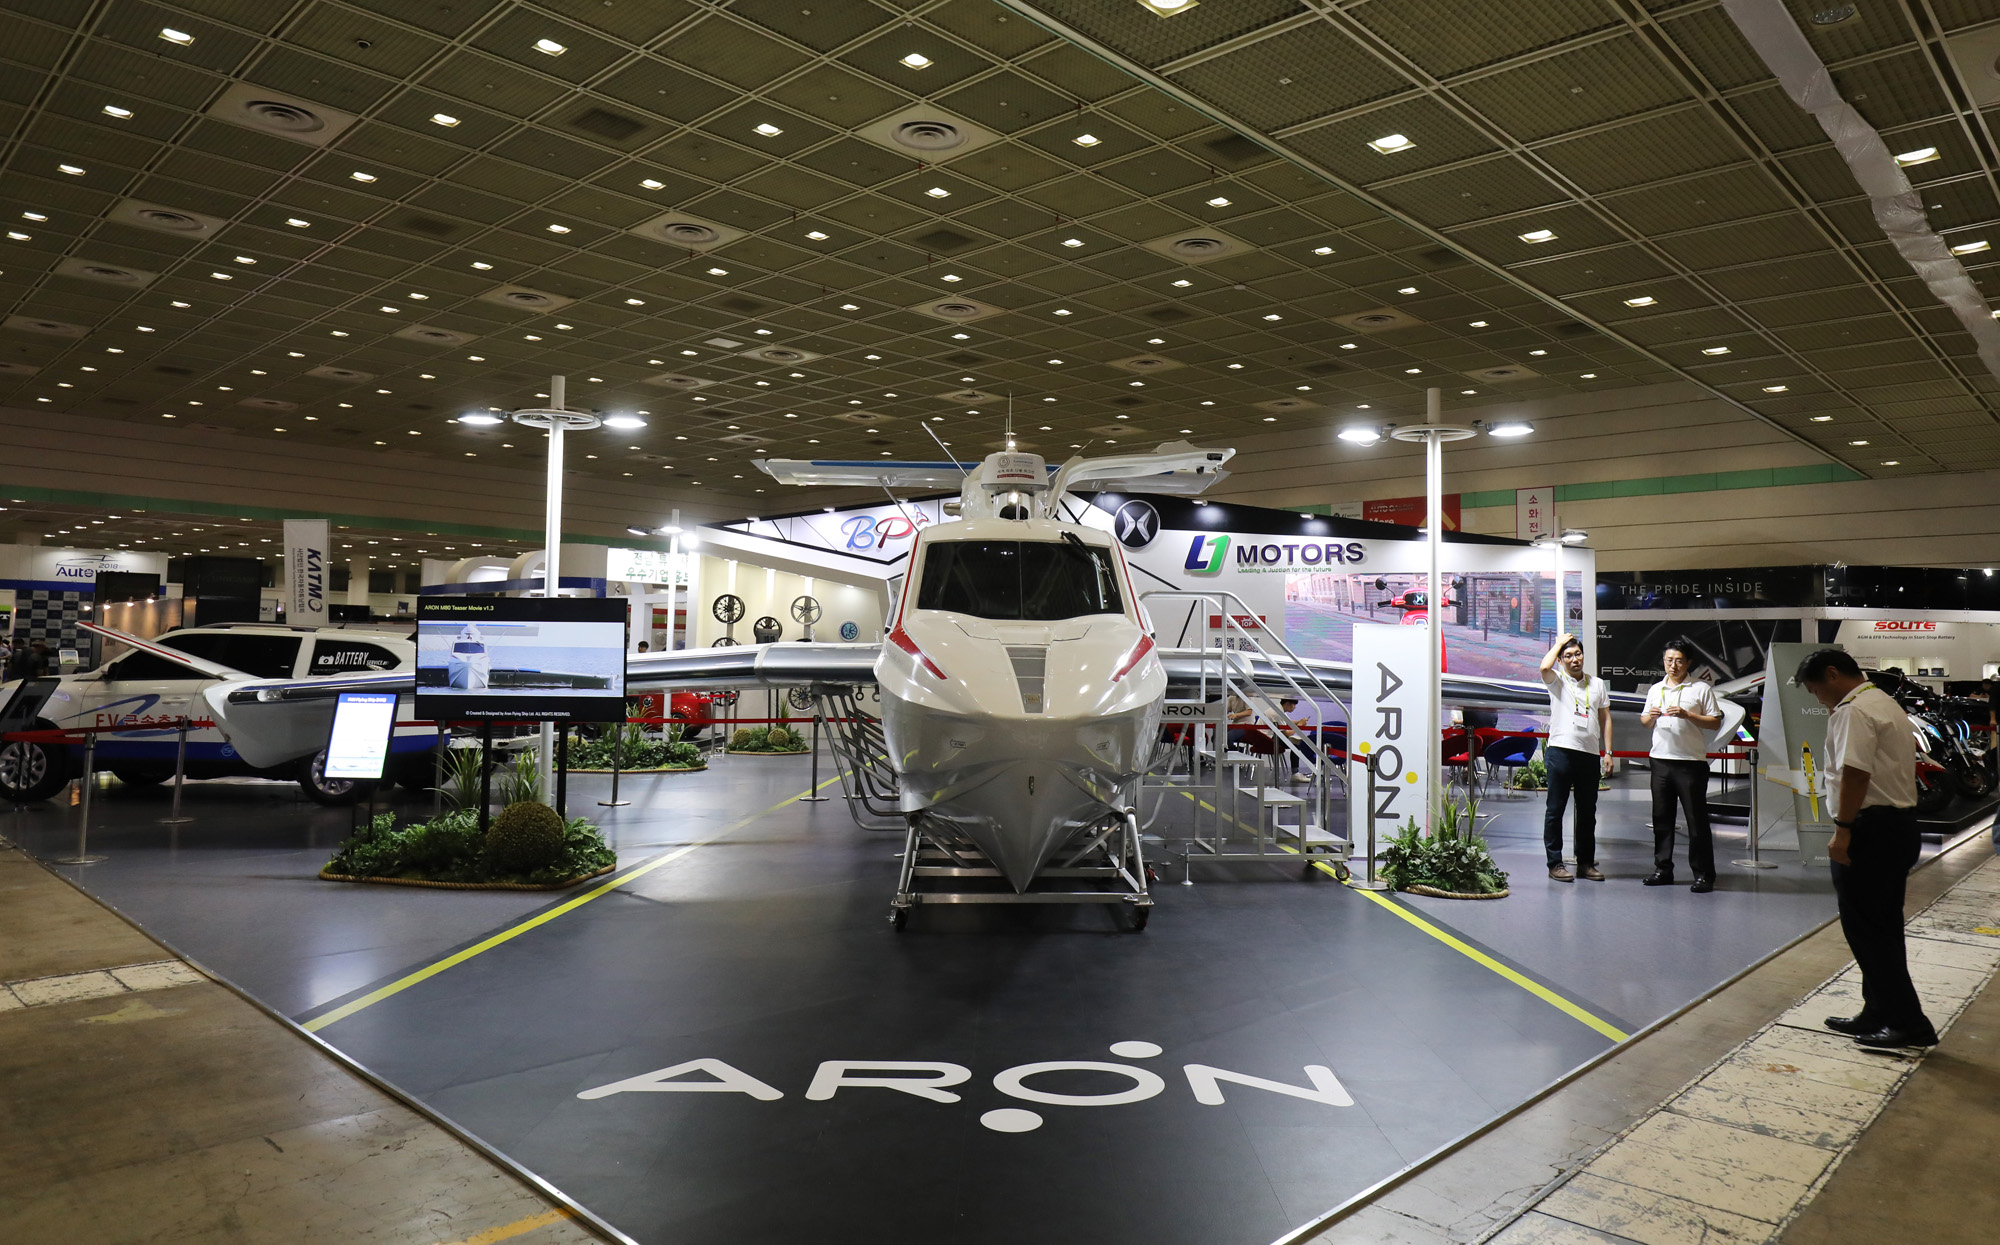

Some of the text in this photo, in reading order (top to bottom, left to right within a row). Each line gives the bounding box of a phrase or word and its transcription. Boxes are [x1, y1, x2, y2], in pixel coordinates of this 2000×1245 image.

[1529, 494, 1539, 533] 소화전
[1236, 543, 1364, 563] MOTORS
[1619, 582, 1763, 595] THE PRIDE INSIDE
[1874, 621, 1937, 631] SOLITE
[335, 651, 369, 665] BATTERY
[1601, 666, 1636, 676] FEX
[1801, 707, 1829, 716] M80
[1375, 662, 1403, 819] ARON
